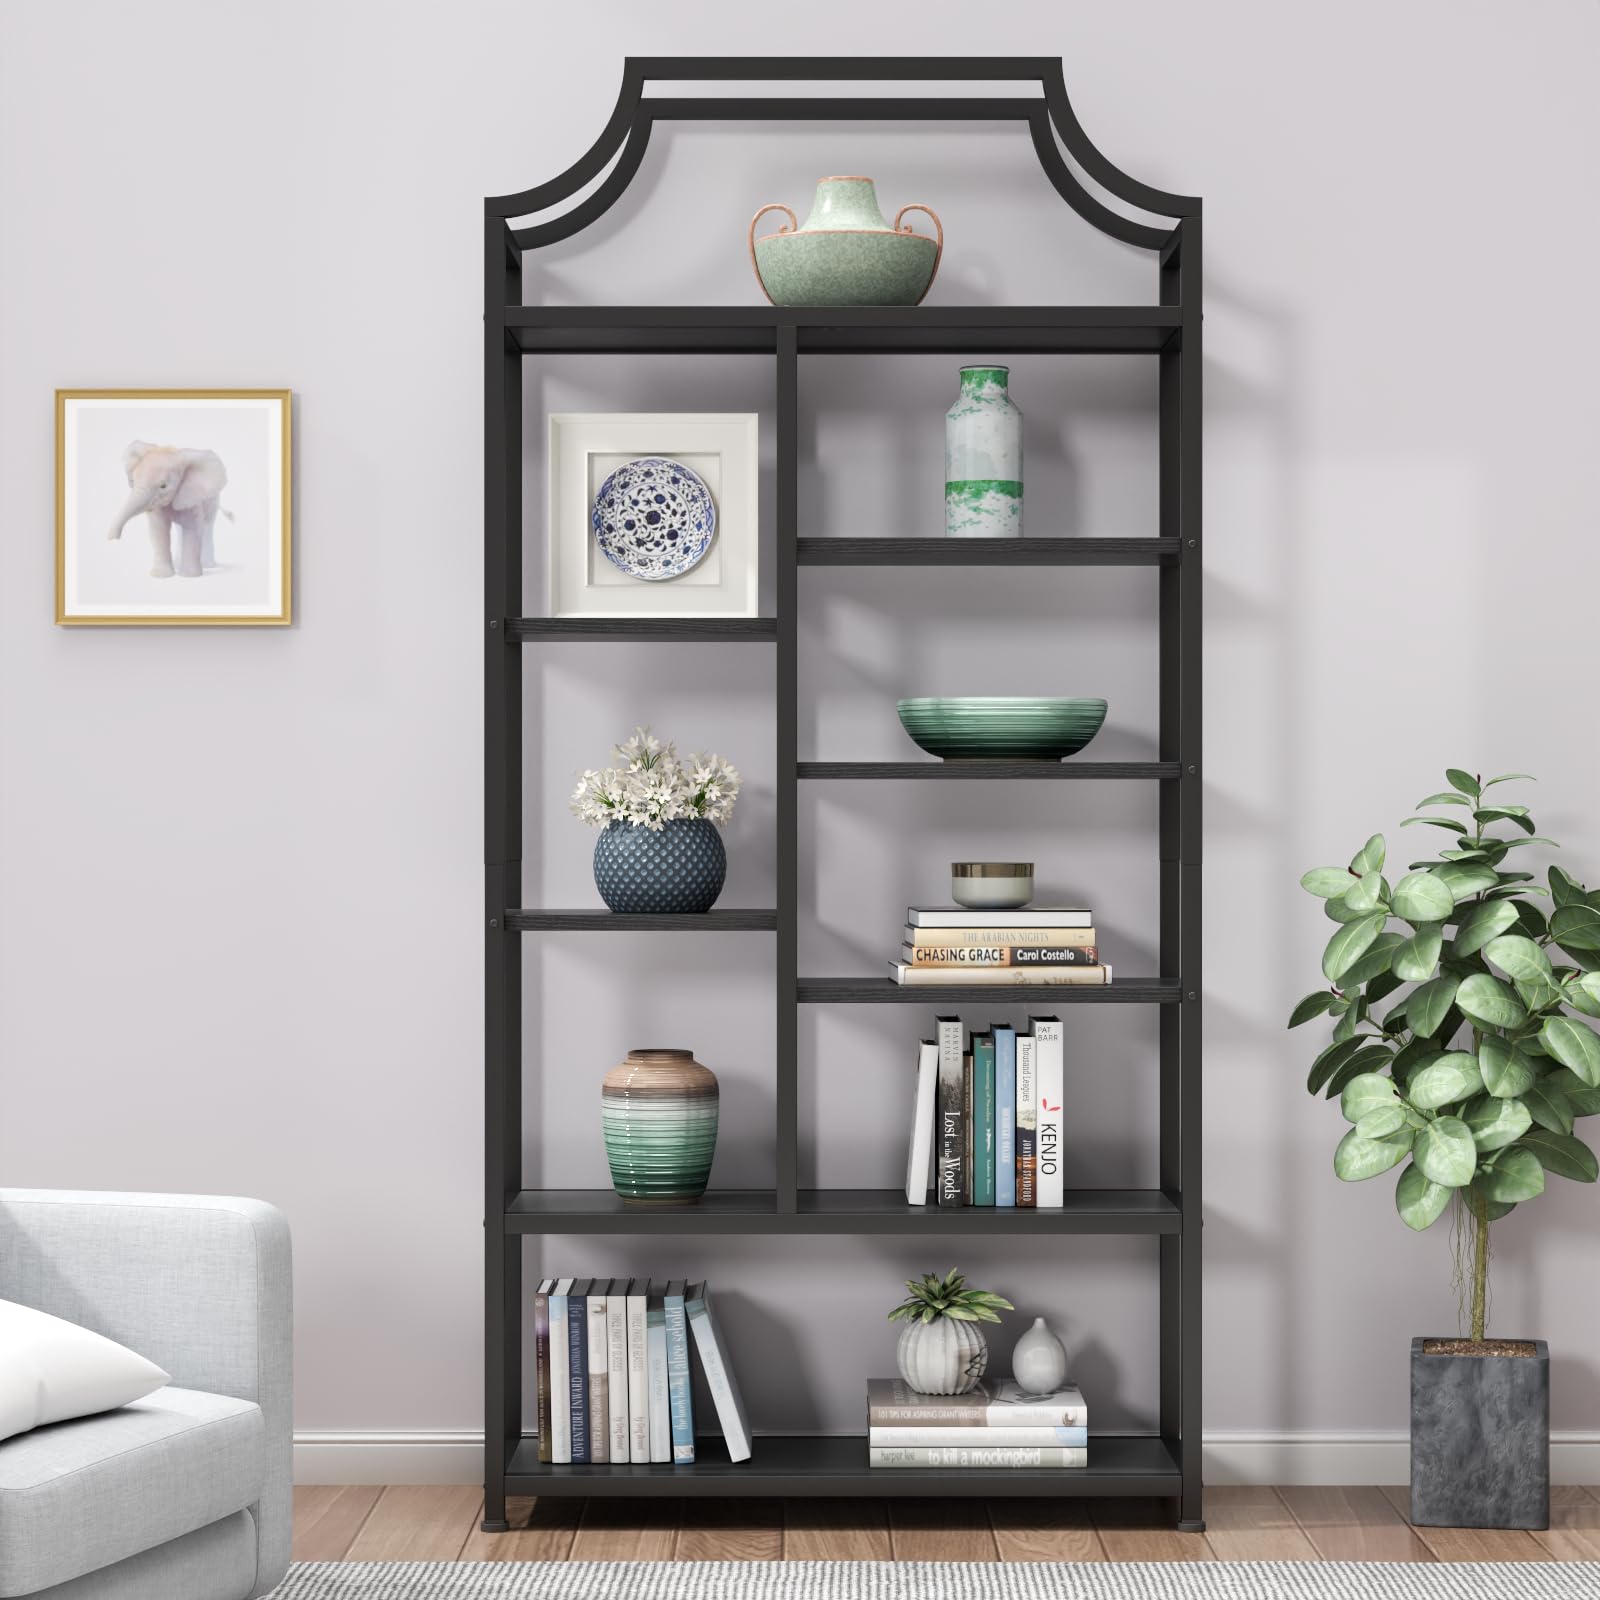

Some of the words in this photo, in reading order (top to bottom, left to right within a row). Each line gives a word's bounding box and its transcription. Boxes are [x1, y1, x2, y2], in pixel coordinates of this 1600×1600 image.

[981, 932, 1016, 942] ARABIAN
[1019, 932, 1049, 942] NIGHTS
[916, 948, 966, 962] CHASING
[968, 948, 1005, 962] GRACE
[1016, 949, 1039, 961] Carol
[1041, 949, 1075, 961] Costello
[1038, 1026, 1051, 1034] PAT
[1038, 1034, 1058, 1042] BARR
[1022, 1043, 1032, 1075] Thousand
[1020, 1075, 1032, 1102] Leagues
[944, 1111, 961, 1138] Lost
[944, 1149, 953, 1158] the
[1041, 1123, 1057, 1176] KENJO
[944, 1157, 961, 1200] Woods
[665, 1306, 684, 1342] sebold
[668, 1345, 687, 1369] alice
[571, 1376, 583, 1409] INWARD
[571, 1411, 585, 1459] ADVENTURE
[928, 1449, 940, 1465] to
[943, 1447, 957, 1465] kill
[960, 1451, 968, 1465] a
[971, 1447, 1041, 1467] mockingbird
